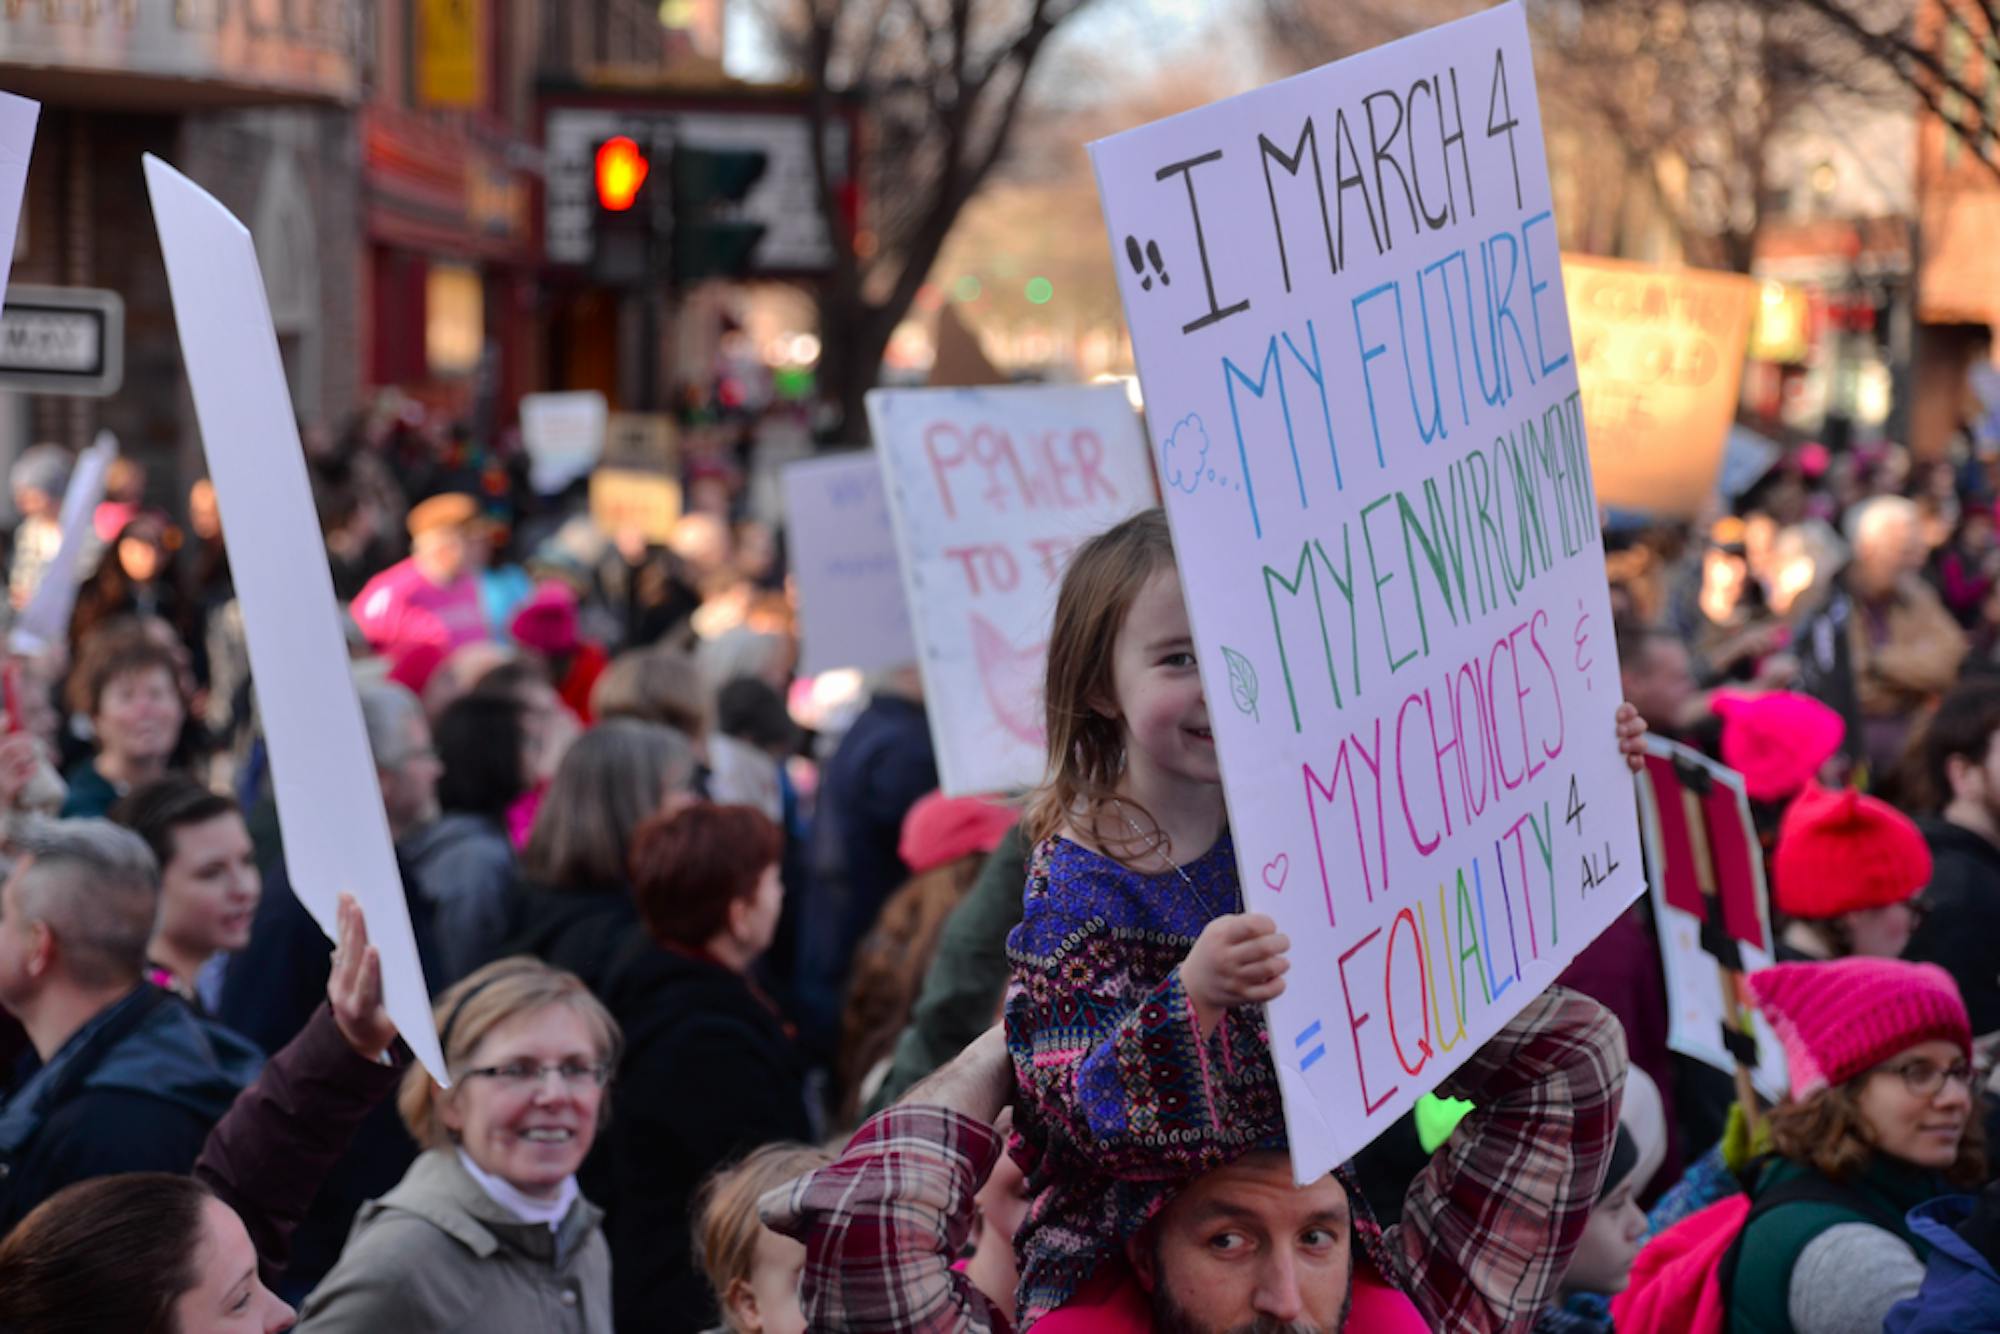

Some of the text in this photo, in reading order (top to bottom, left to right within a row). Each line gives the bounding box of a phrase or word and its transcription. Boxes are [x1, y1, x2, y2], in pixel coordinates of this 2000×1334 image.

[1155, 47, 1519, 335] I MARCH 4
[1222, 210, 1569, 539] MY FUTURE
[944, 542, 1020, 597] TO
[1262, 390, 1596, 732] MY ENVIRONMENT
[1303, 718, 1388, 927] MY
[1397, 609, 1564, 856] CHOICES
[1565, 773, 1586, 836] 4
[1581, 842, 1619, 899] ALL
[1338, 802, 1559, 1116] EQUALITY
